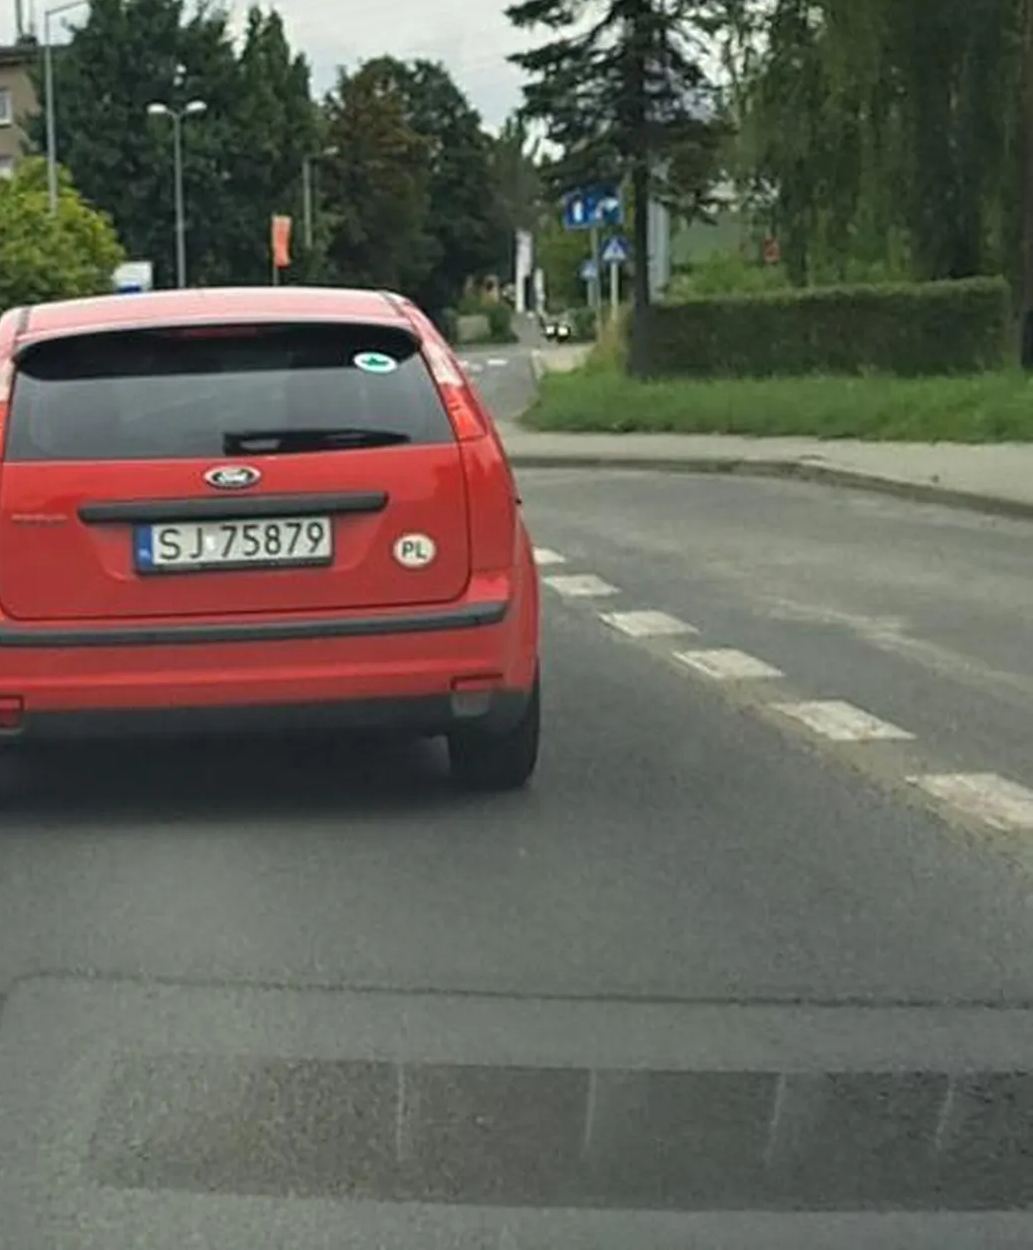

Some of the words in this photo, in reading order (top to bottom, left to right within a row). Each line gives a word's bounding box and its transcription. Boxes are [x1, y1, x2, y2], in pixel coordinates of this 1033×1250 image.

[159, 526, 204, 560] SJ
[220, 521, 324, 558] 75879
[402, 540, 427, 559] PL
